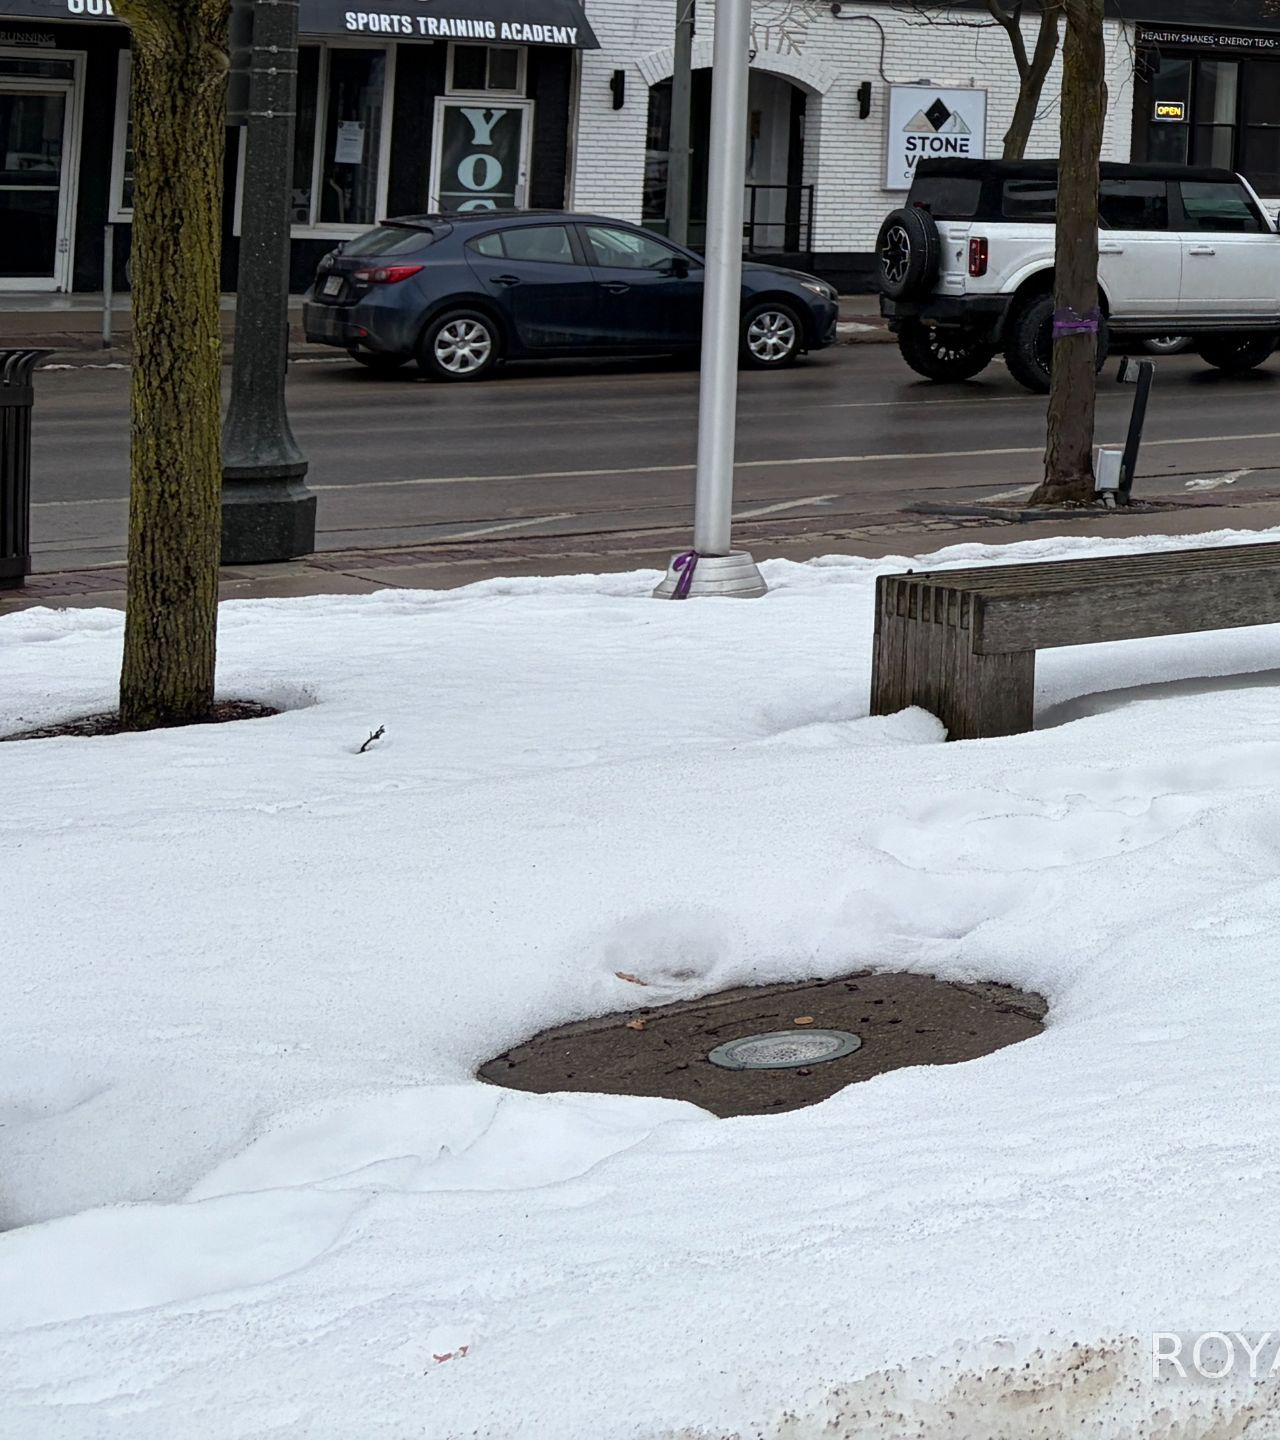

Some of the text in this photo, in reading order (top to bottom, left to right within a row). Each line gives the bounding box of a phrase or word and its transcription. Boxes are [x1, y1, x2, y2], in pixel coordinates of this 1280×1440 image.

[345, 11, 578, 45] SPORTS TRAINING ACADEMY
[1141, 31, 1180, 42] HEALTHY
[1181, 33, 1214, 44] SHAKES
[1219, 36, 1253, 47] ENERGY
[1254, 38, 1275, 48] TEAS
[1157, 105, 1181, 116] OPEN
[905, 136, 971, 153] STONE
